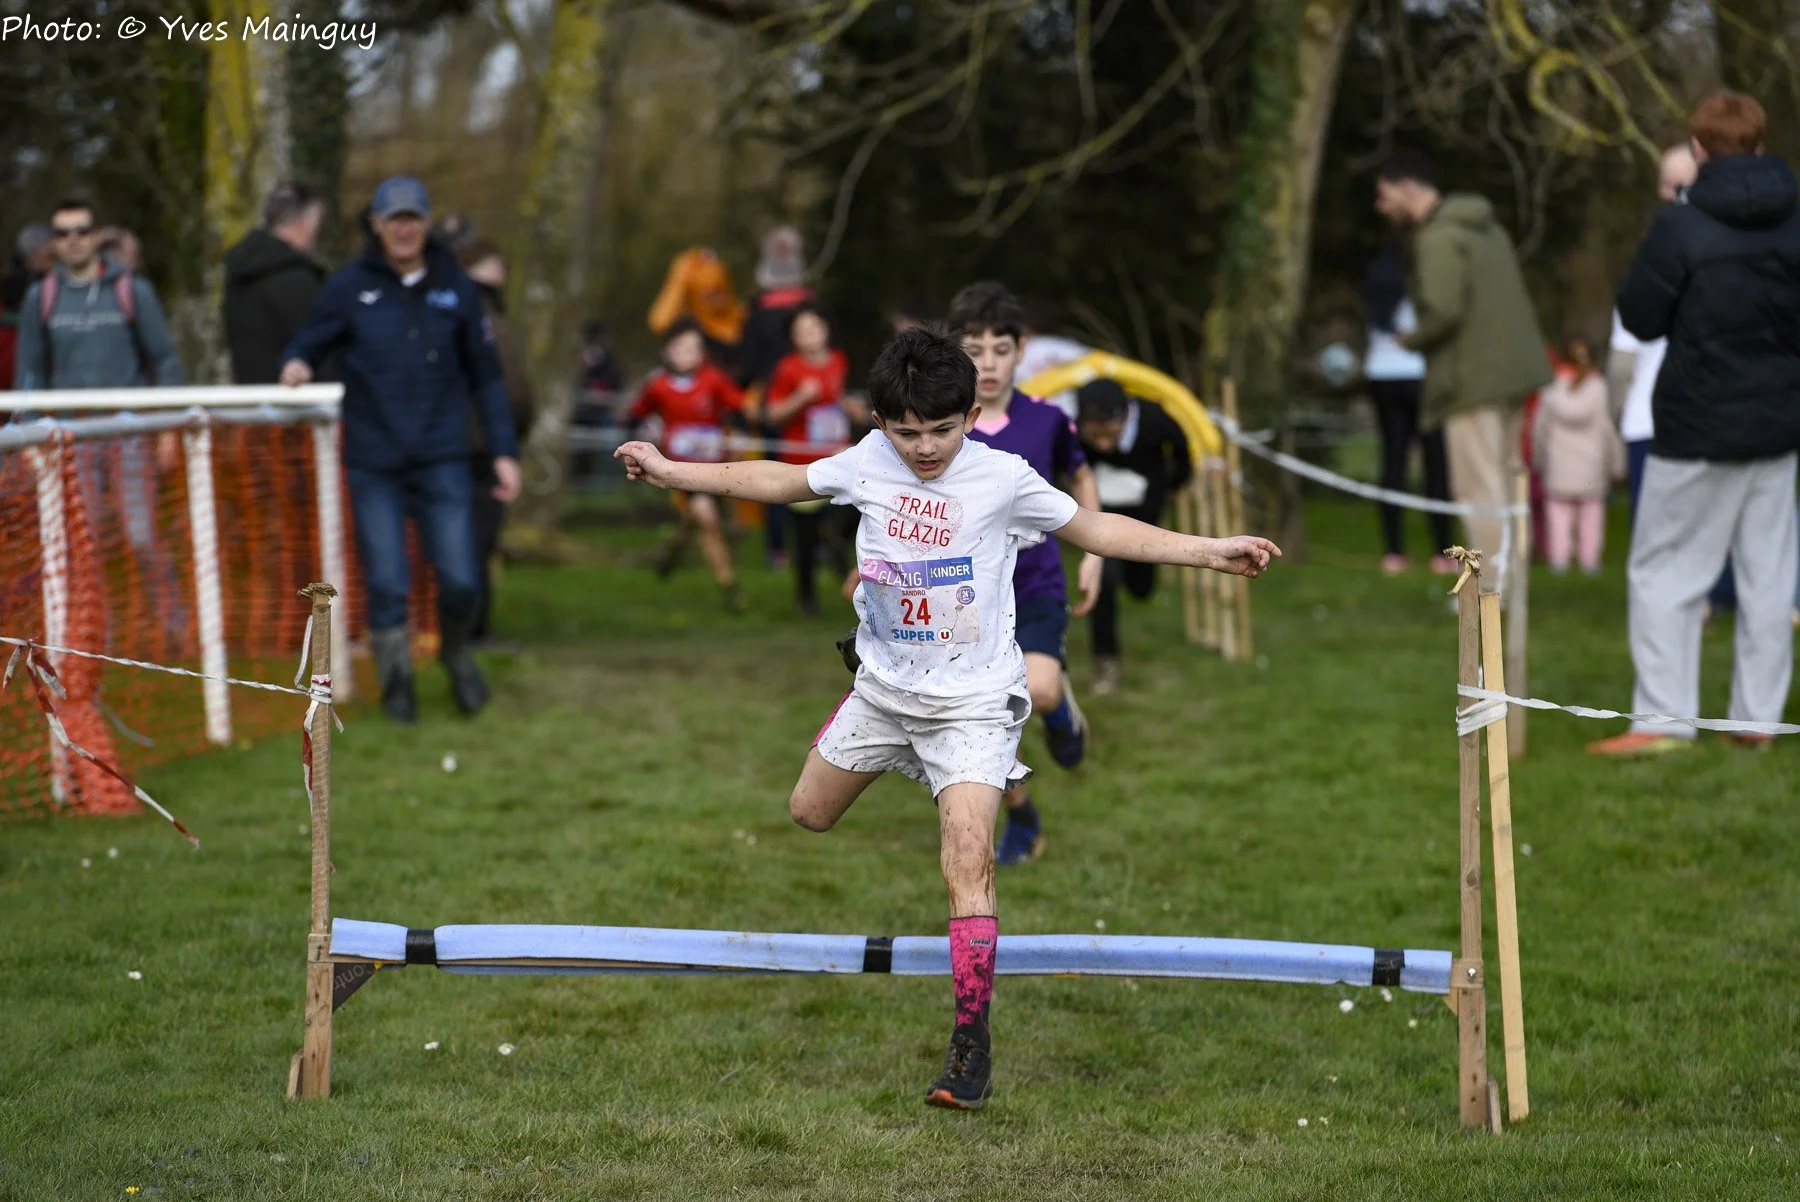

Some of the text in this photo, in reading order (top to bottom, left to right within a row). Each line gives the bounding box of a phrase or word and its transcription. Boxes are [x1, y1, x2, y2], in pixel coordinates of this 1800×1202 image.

[900, 496, 948, 520] TRAIL
[888, 519, 951, 547] GLAZIG
[878, 570, 922, 587] GLAZIG
[930, 564, 970, 578] KINDER
[901, 598, 931, 626] 24
[893, 628, 935, 641] SUPER
